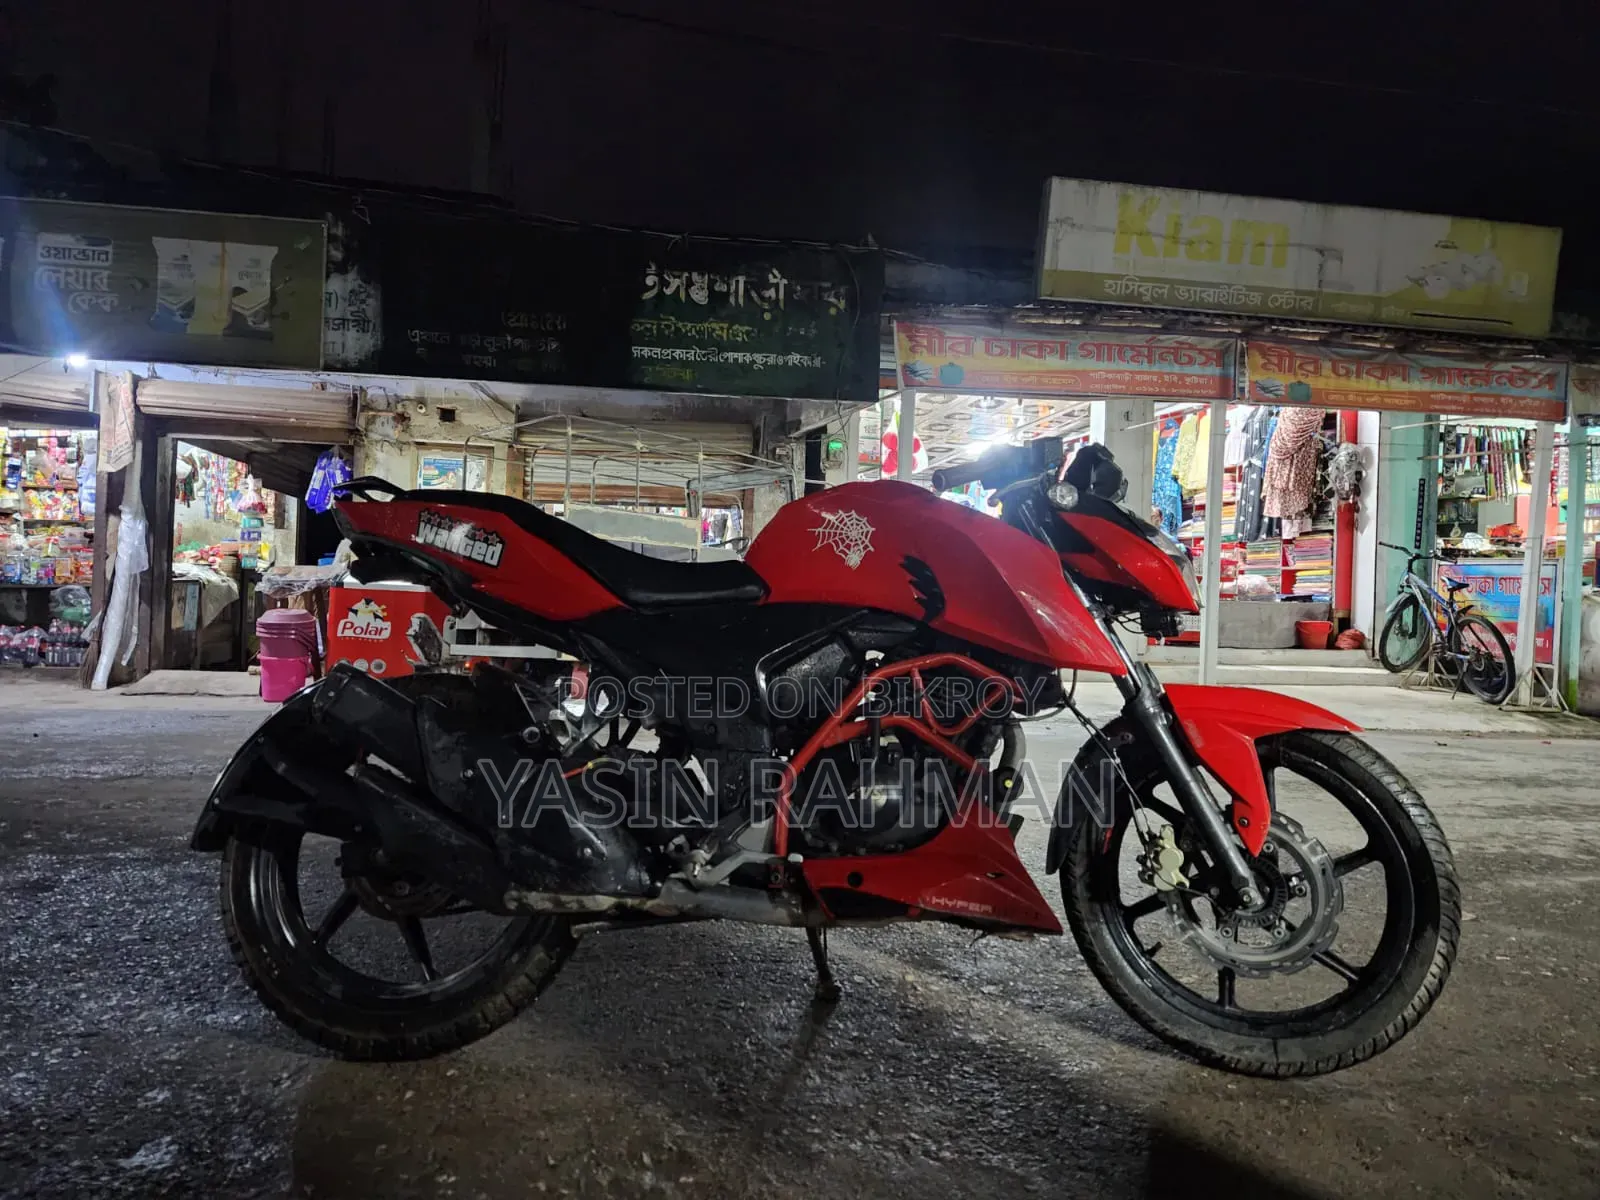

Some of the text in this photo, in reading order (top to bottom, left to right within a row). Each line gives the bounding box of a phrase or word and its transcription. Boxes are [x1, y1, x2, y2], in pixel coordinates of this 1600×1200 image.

[1113, 193, 1290, 269] Kiam
[1103, 275, 1169, 301] হাসিবুল
[909, 326, 974, 358] মীর
[1260, 346, 1322, 378] মীর
[341, 621, 388, 637] Polar
